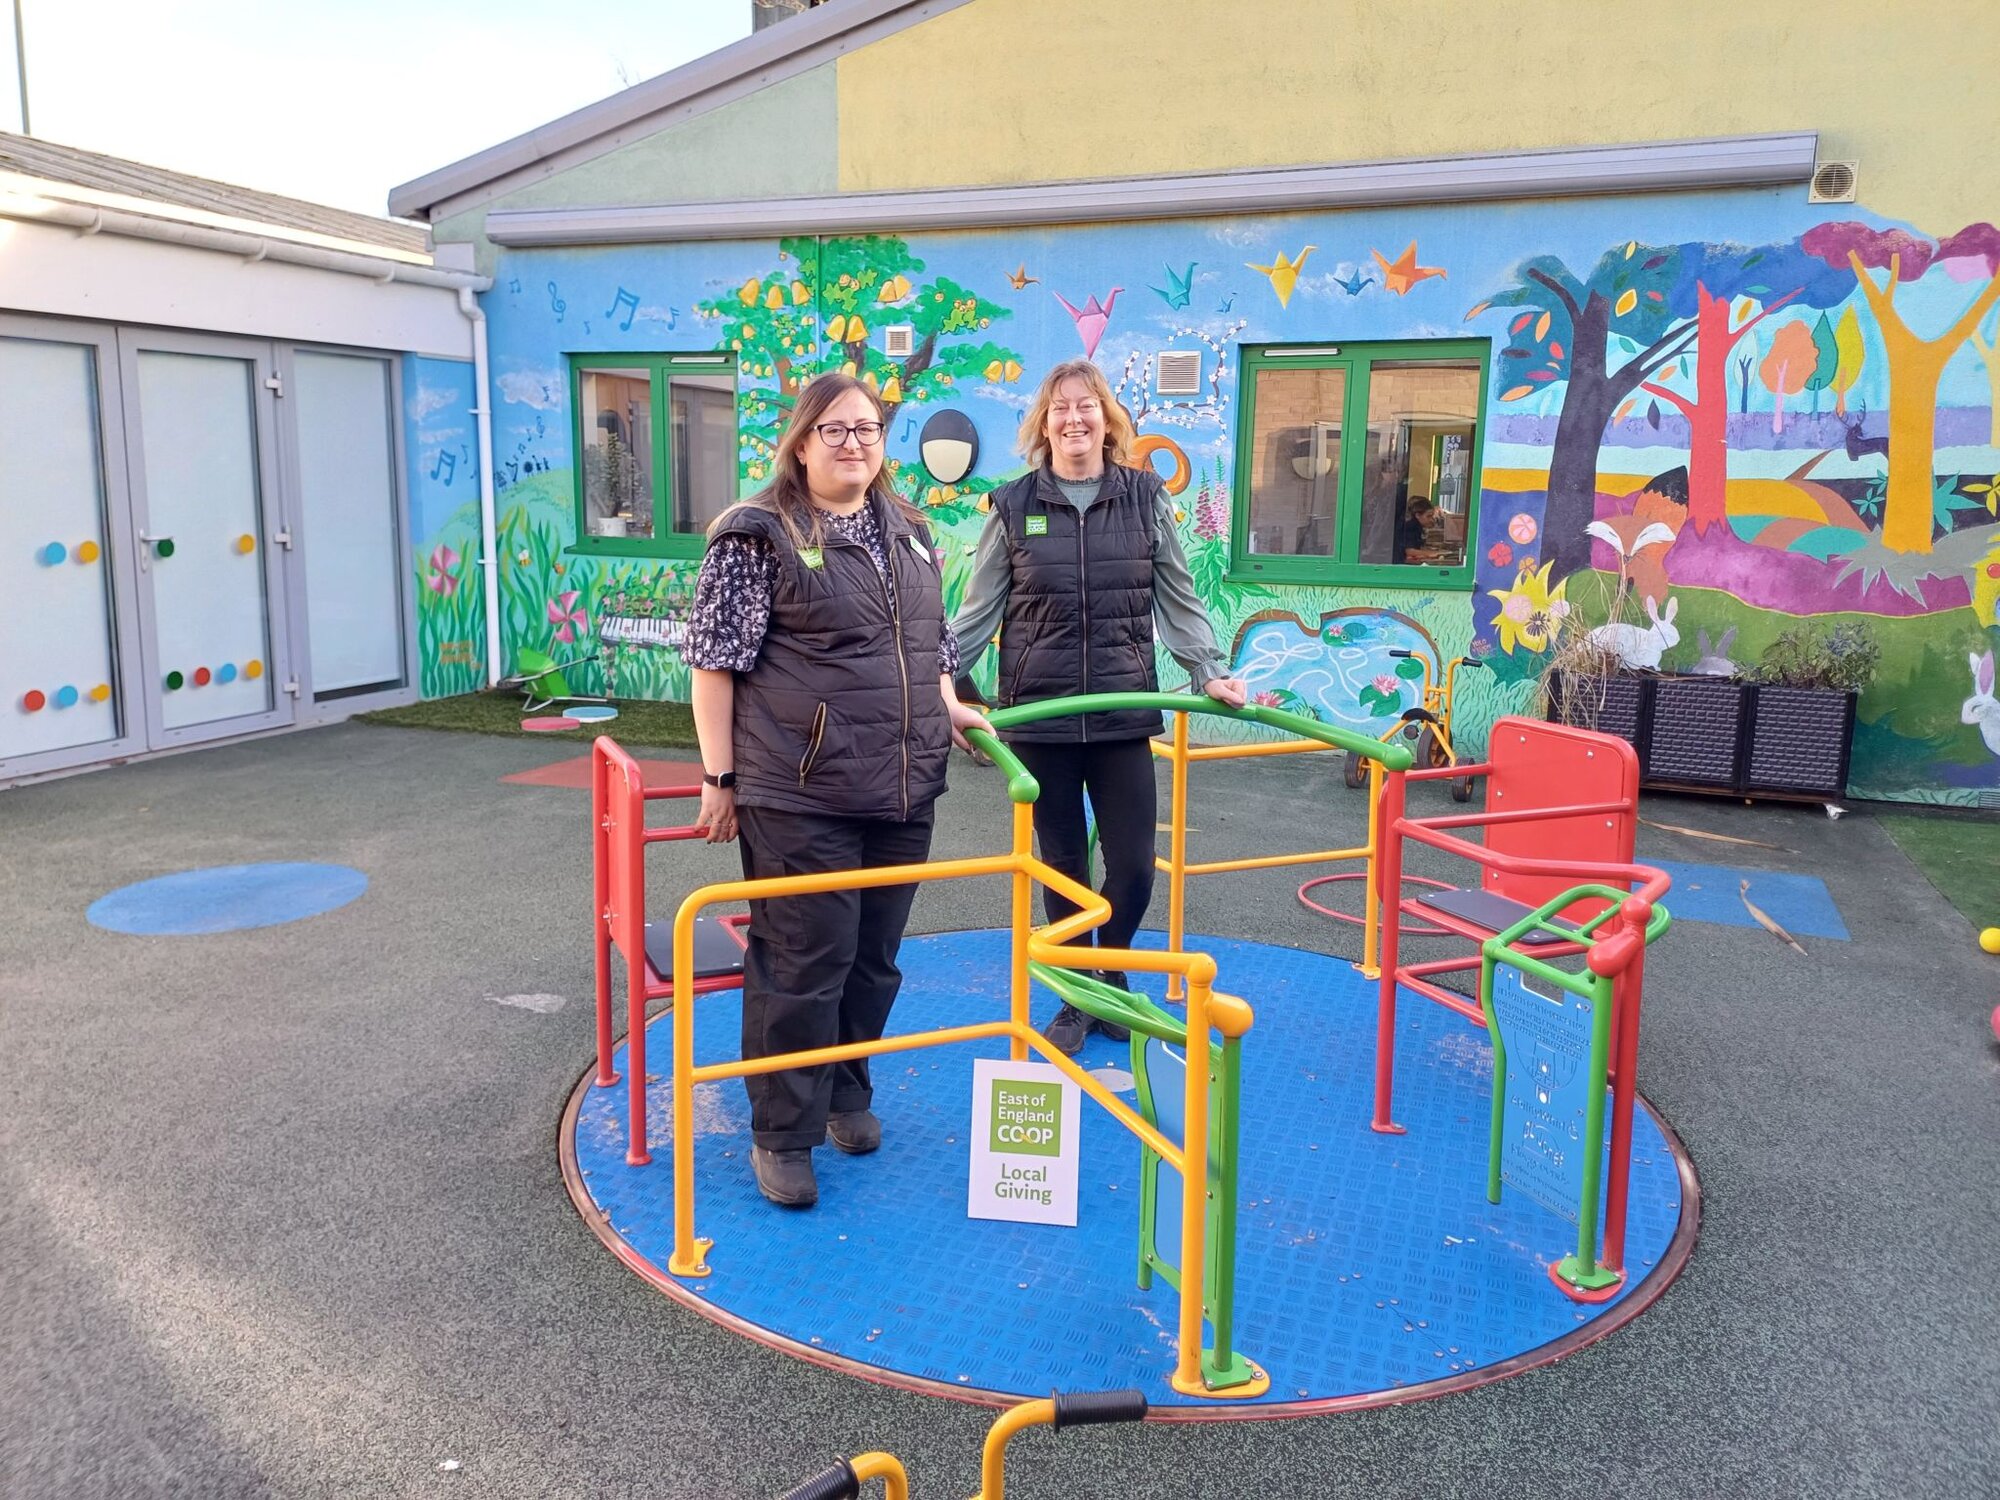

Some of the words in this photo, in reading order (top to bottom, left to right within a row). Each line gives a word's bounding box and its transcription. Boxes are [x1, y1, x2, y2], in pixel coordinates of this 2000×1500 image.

[999, 1091, 1029, 1106] East
[1031, 1093, 1046, 1107] of
[998, 1107, 1054, 1123] England
[997, 1125, 1053, 1145] COOP
[1001, 1163, 1047, 1182] Local
[994, 1182, 1052, 1206] Giving
